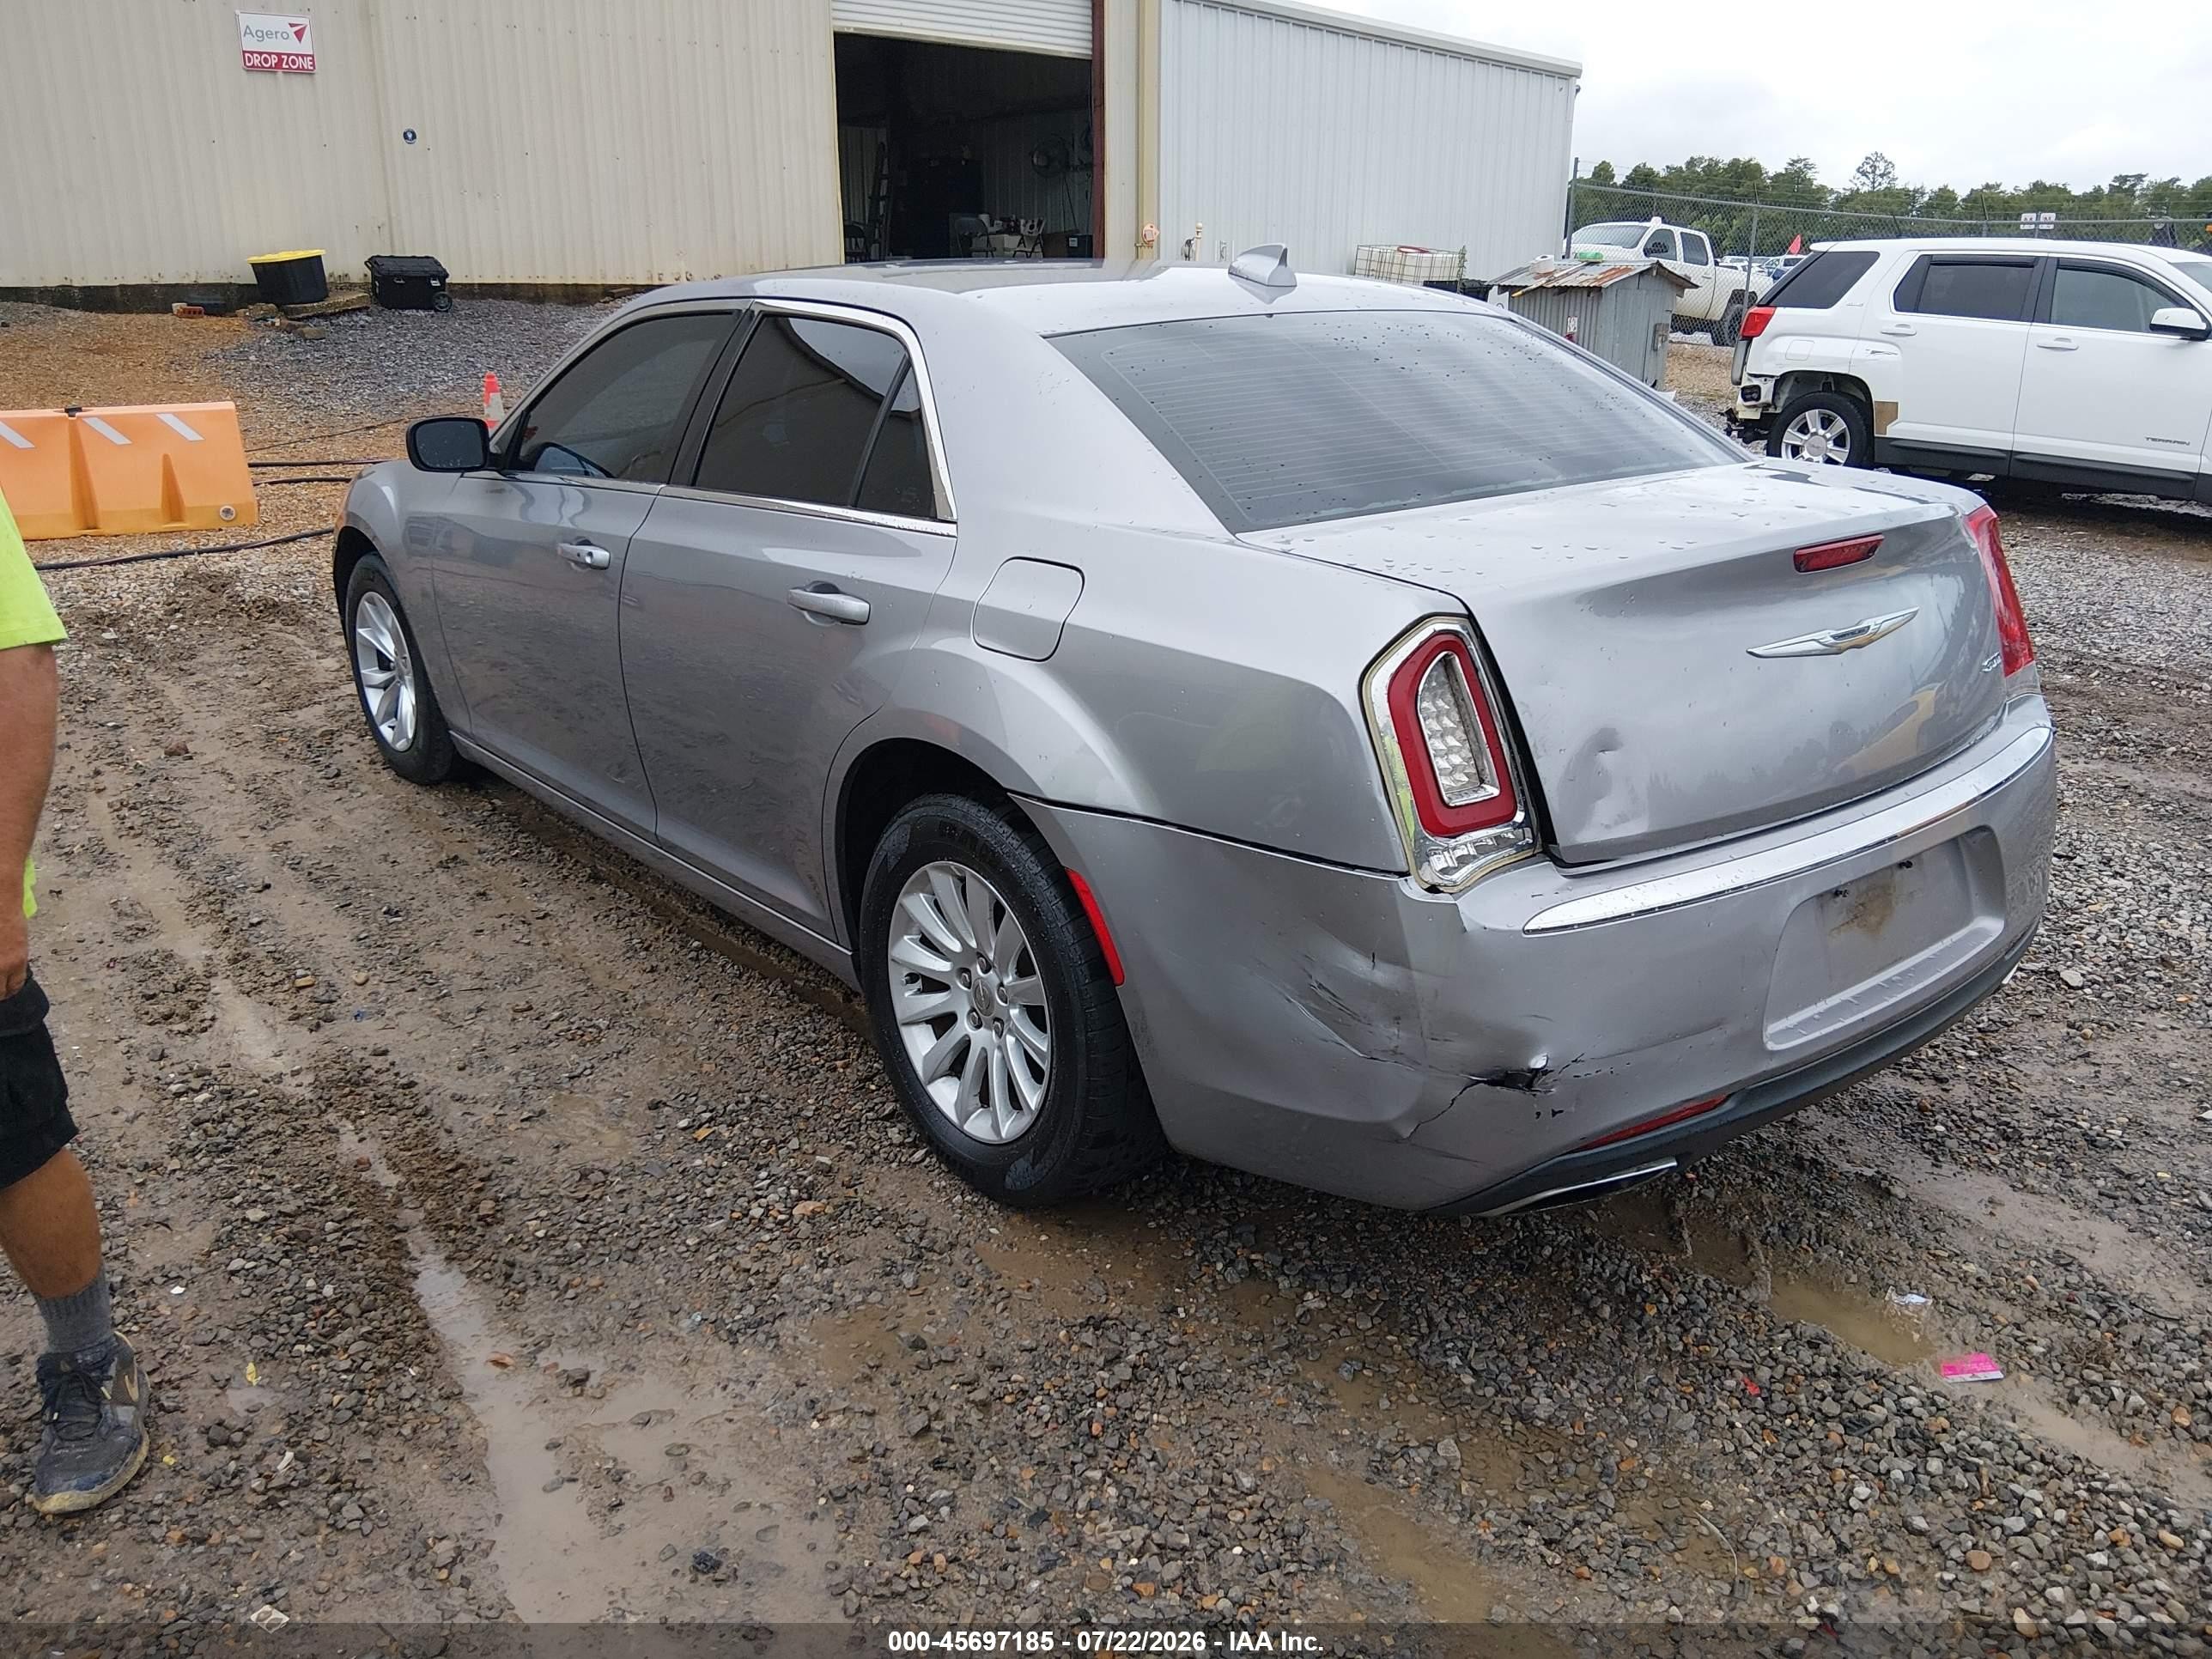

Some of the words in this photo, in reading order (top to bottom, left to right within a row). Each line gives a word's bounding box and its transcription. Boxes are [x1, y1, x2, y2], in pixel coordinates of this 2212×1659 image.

[243, 25, 290, 42] Agero
[245, 52, 278, 67] DROP
[281, 55, 313, 70] ZONE
